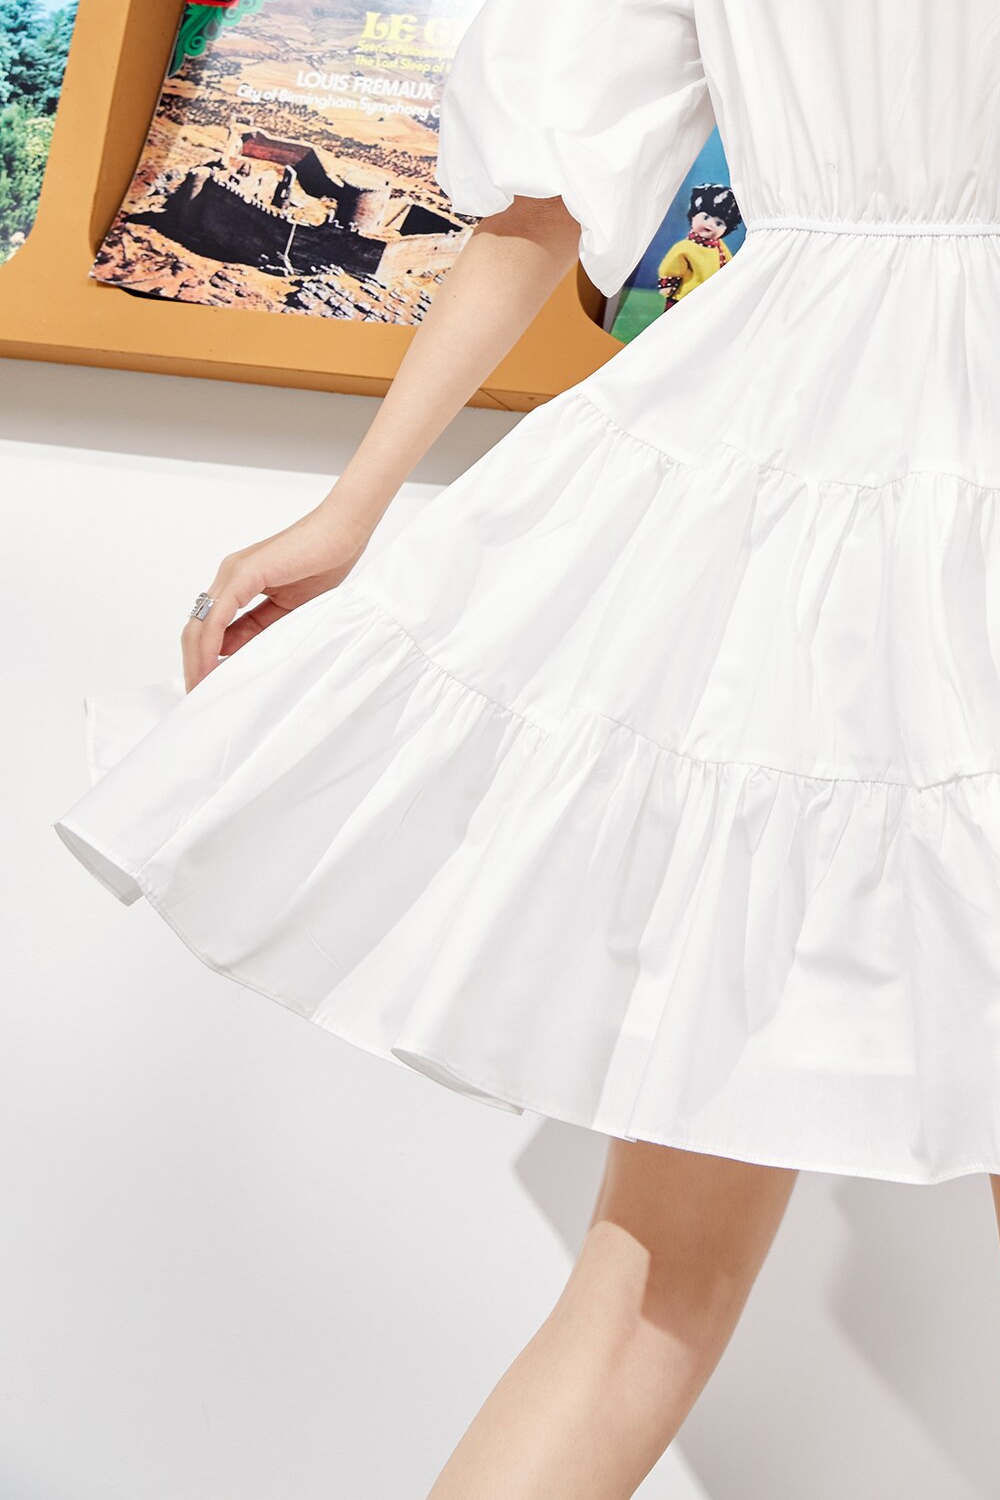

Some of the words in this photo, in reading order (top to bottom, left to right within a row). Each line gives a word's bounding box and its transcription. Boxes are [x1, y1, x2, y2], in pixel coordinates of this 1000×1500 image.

[295, 70, 350, 92] LOUIS
[350, 74, 436, 100] FRÉMAUX
[236, 84, 262, 102] City
[262, 87, 278, 101] of
[278, 88, 358, 109] Birmingham
[359, 98, 430, 120] Symphony
